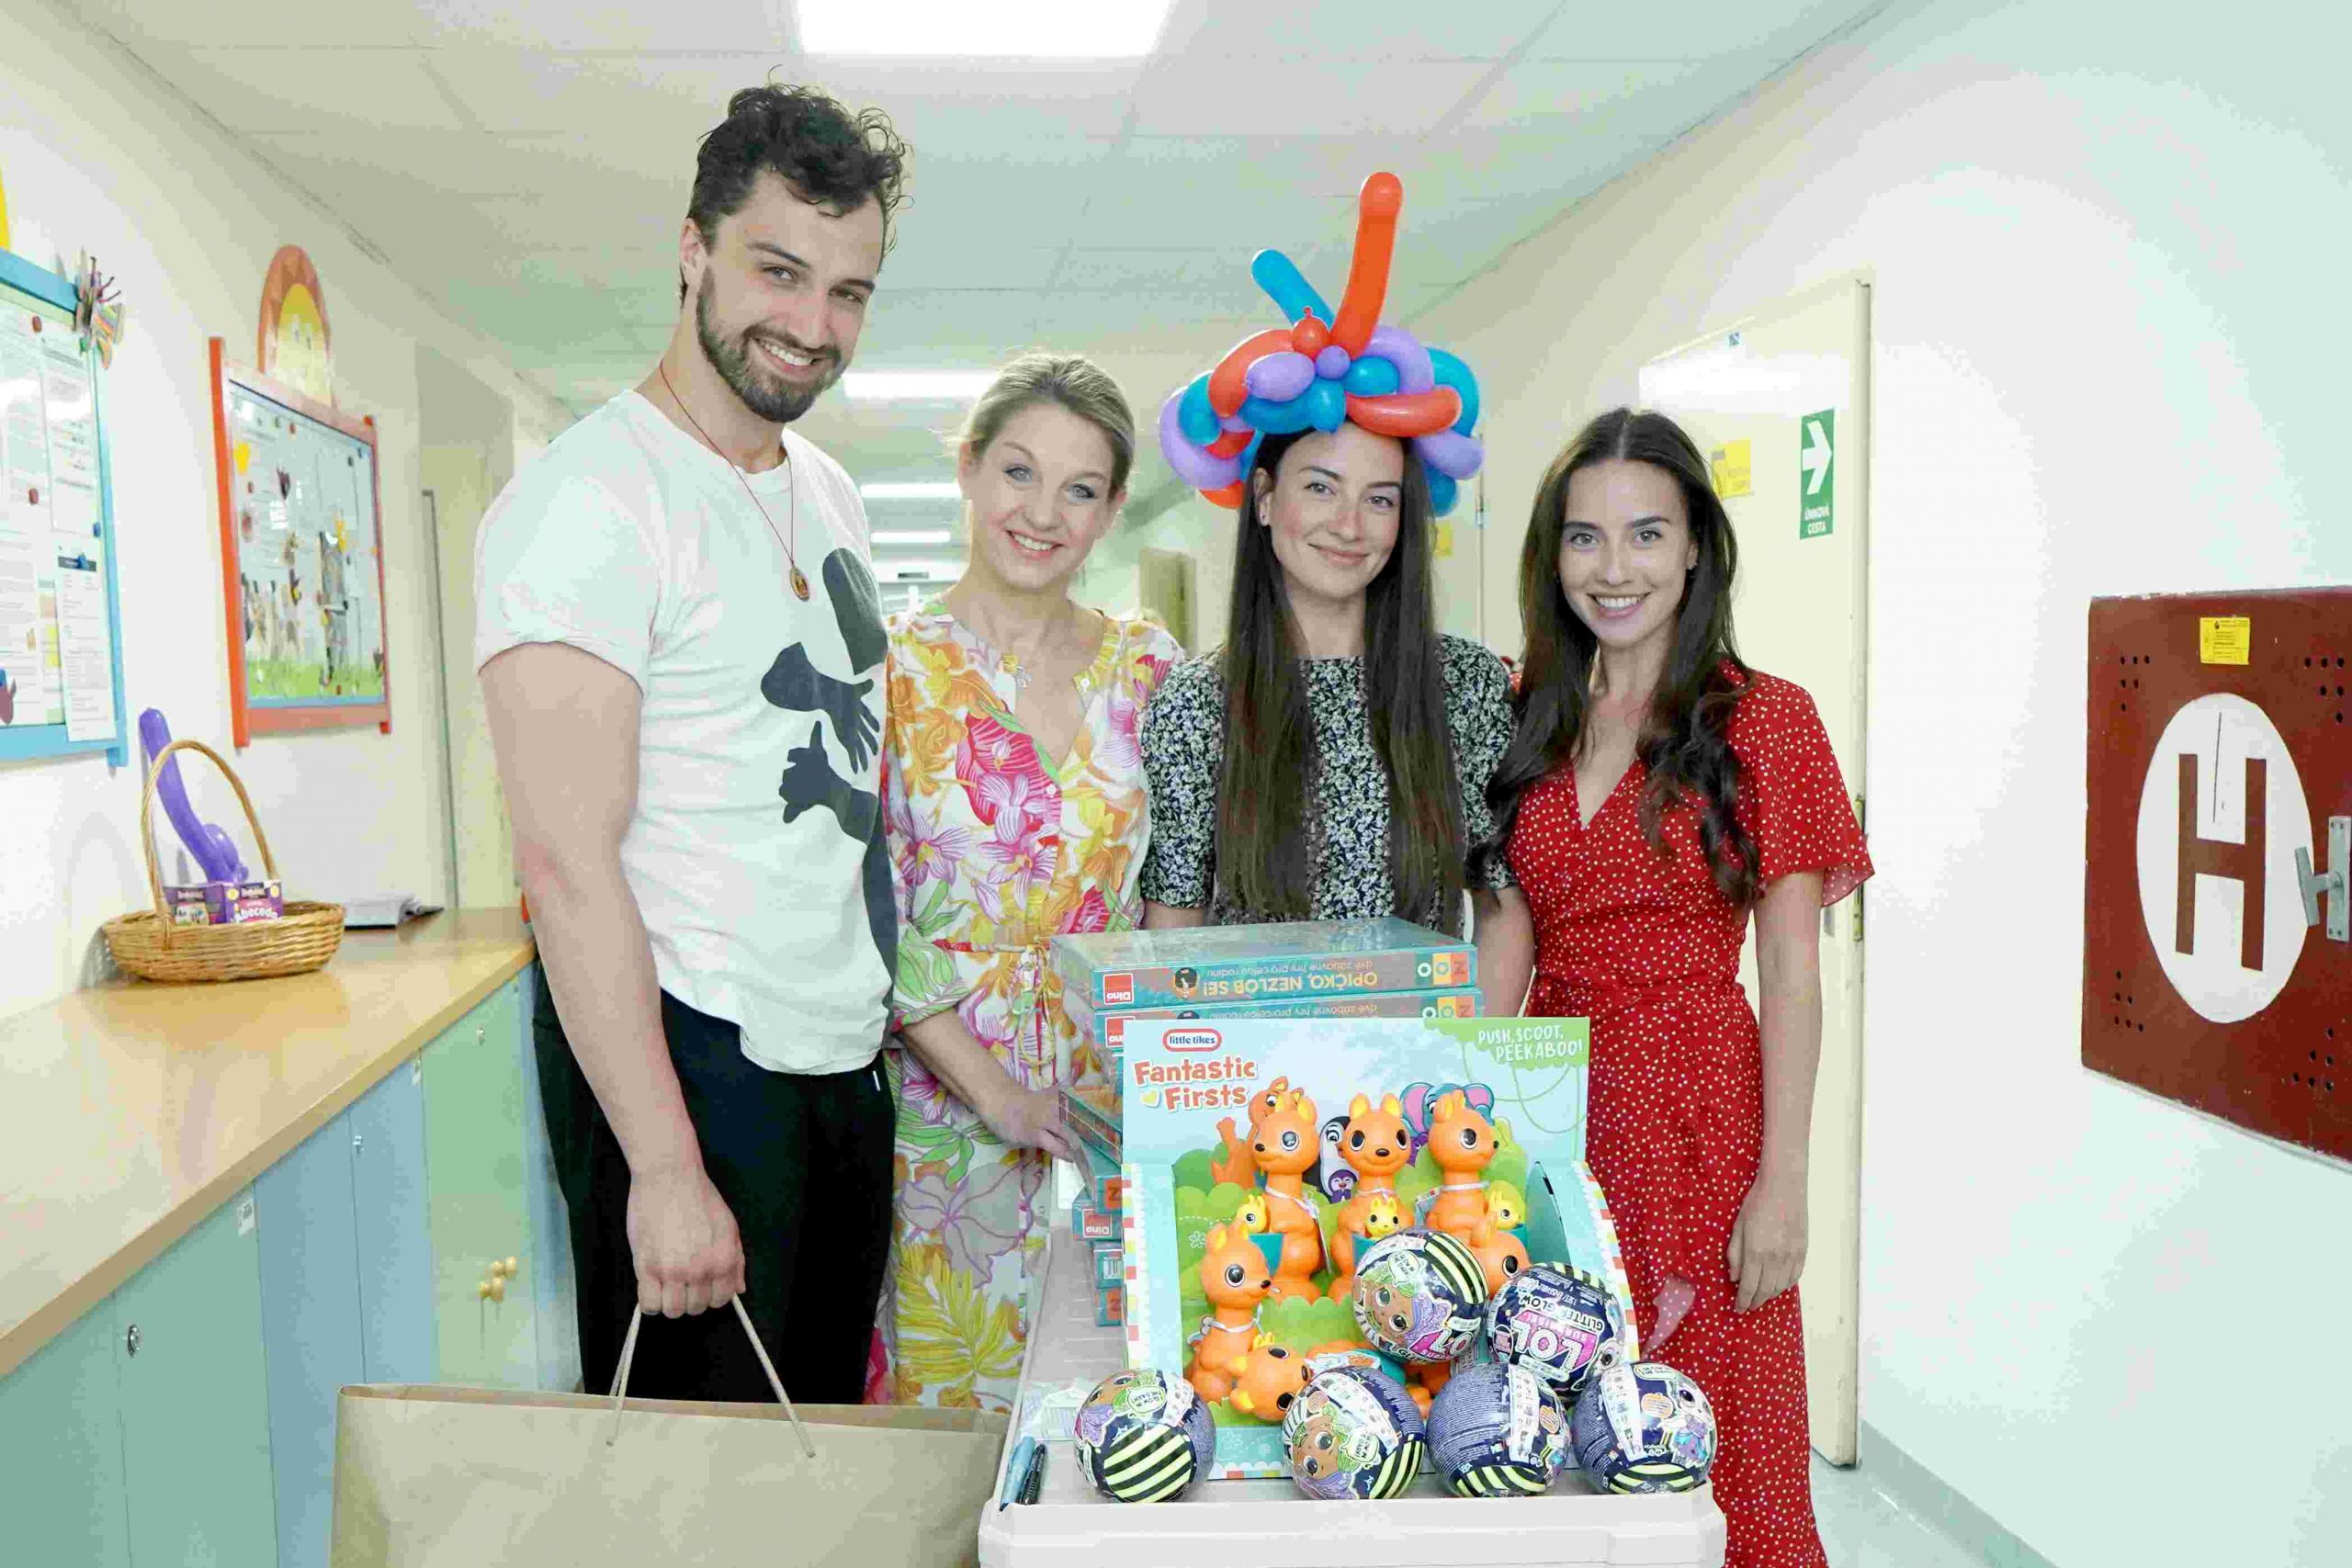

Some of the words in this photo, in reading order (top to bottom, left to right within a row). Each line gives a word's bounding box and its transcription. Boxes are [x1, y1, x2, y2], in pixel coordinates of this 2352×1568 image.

[2176, 753, 2267, 971] H
[1204, 980, 1229, 996] SE!
[1233, 976, 1303, 995] NEZLOB
[1106, 991, 1132, 1001] Dino
[1169, 1035, 1192, 1044] little
[1193, 1035, 1216, 1044] tikes
[1516, 1024, 1565, 1042] SCOOT,
[1496, 1038, 1583, 1062] PEEKABOO!
[1133, 1055, 1257, 1086] Fantastic
[1164, 1084, 1248, 1111] Firsts
